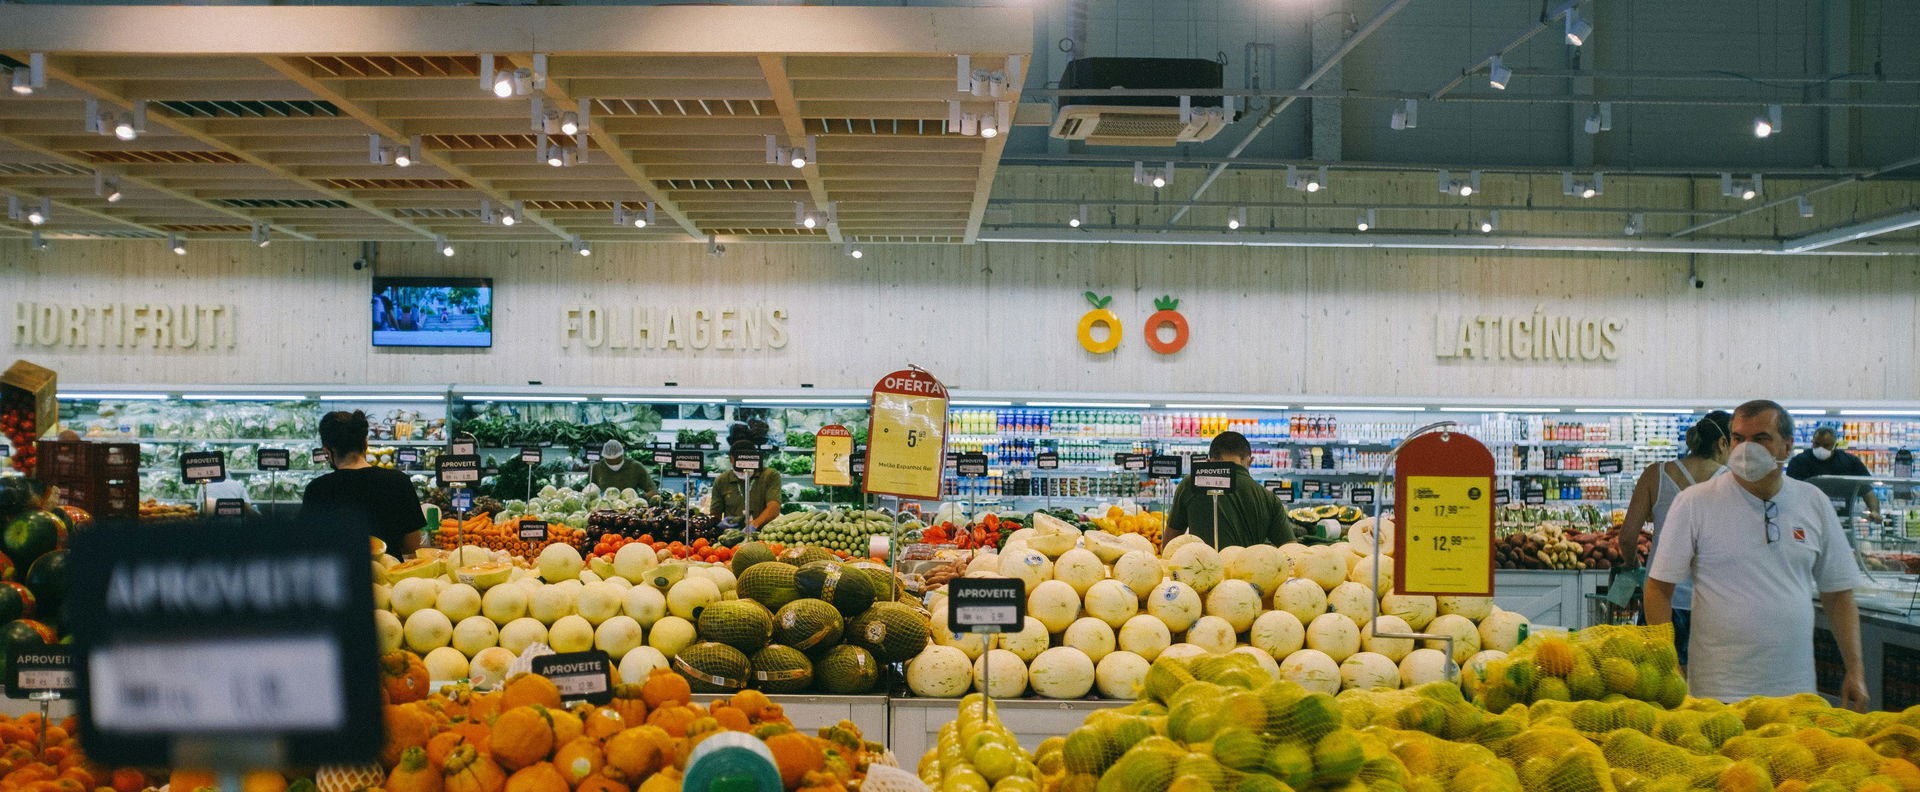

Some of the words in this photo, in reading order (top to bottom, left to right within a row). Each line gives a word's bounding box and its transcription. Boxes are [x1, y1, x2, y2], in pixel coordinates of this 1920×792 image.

[13, 302, 237, 349] HORTIFRUTI
[560, 304, 789, 351] FOLHAGENS
[1435, 303, 1624, 361] LATICÍNIOS
[884, 377, 943, 394] OFERTA
[821, 428, 849, 436] OFERTA
[185, 457, 219, 465] APROVEITE
[441, 460, 477, 468] APROVEITE
[106, 556, 345, 612] APROVEITE
[958, 588, 1016, 598] APROVEITE
[17, 654, 72, 665] APROVEIT
[543, 660, 602, 675] APROVEITE
